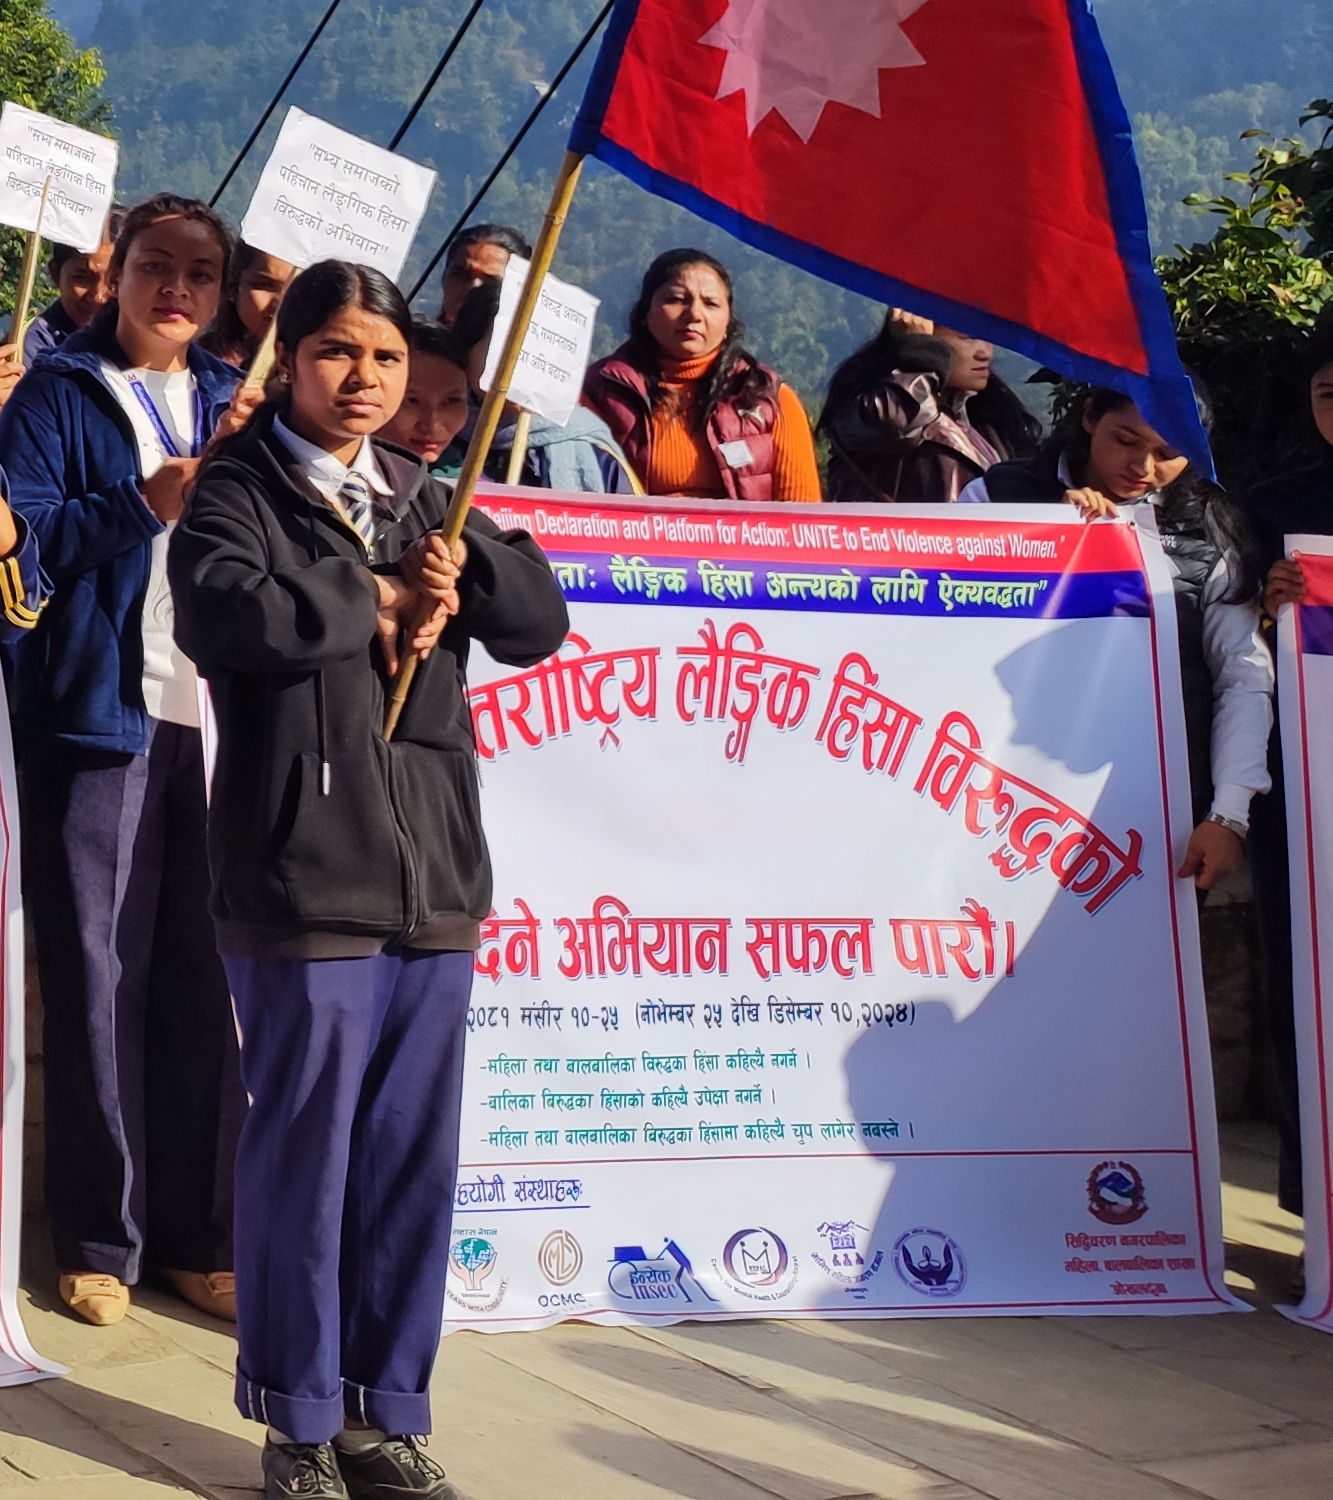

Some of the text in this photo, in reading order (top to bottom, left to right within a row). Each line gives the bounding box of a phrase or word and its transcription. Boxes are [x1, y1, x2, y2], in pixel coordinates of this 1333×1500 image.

[279, 164, 321, 195] पहिचान
[342, 155, 401, 195] समाजको
[273, 195, 323, 231] विरुद्धको
[536, 510, 1006, 561] Declaration and Platform for Action: UNITE to End Violence against
[697, 559, 929, 604] हिंसा लागि
[815, 651, 925, 782] हिंसा
[556, 895, 874, 983] अभियान सफल
[629, 1266, 671, 1285] इन्सेक
[633, 1283, 677, 1300] insec
[538, 1293, 586, 1307] OCMC
